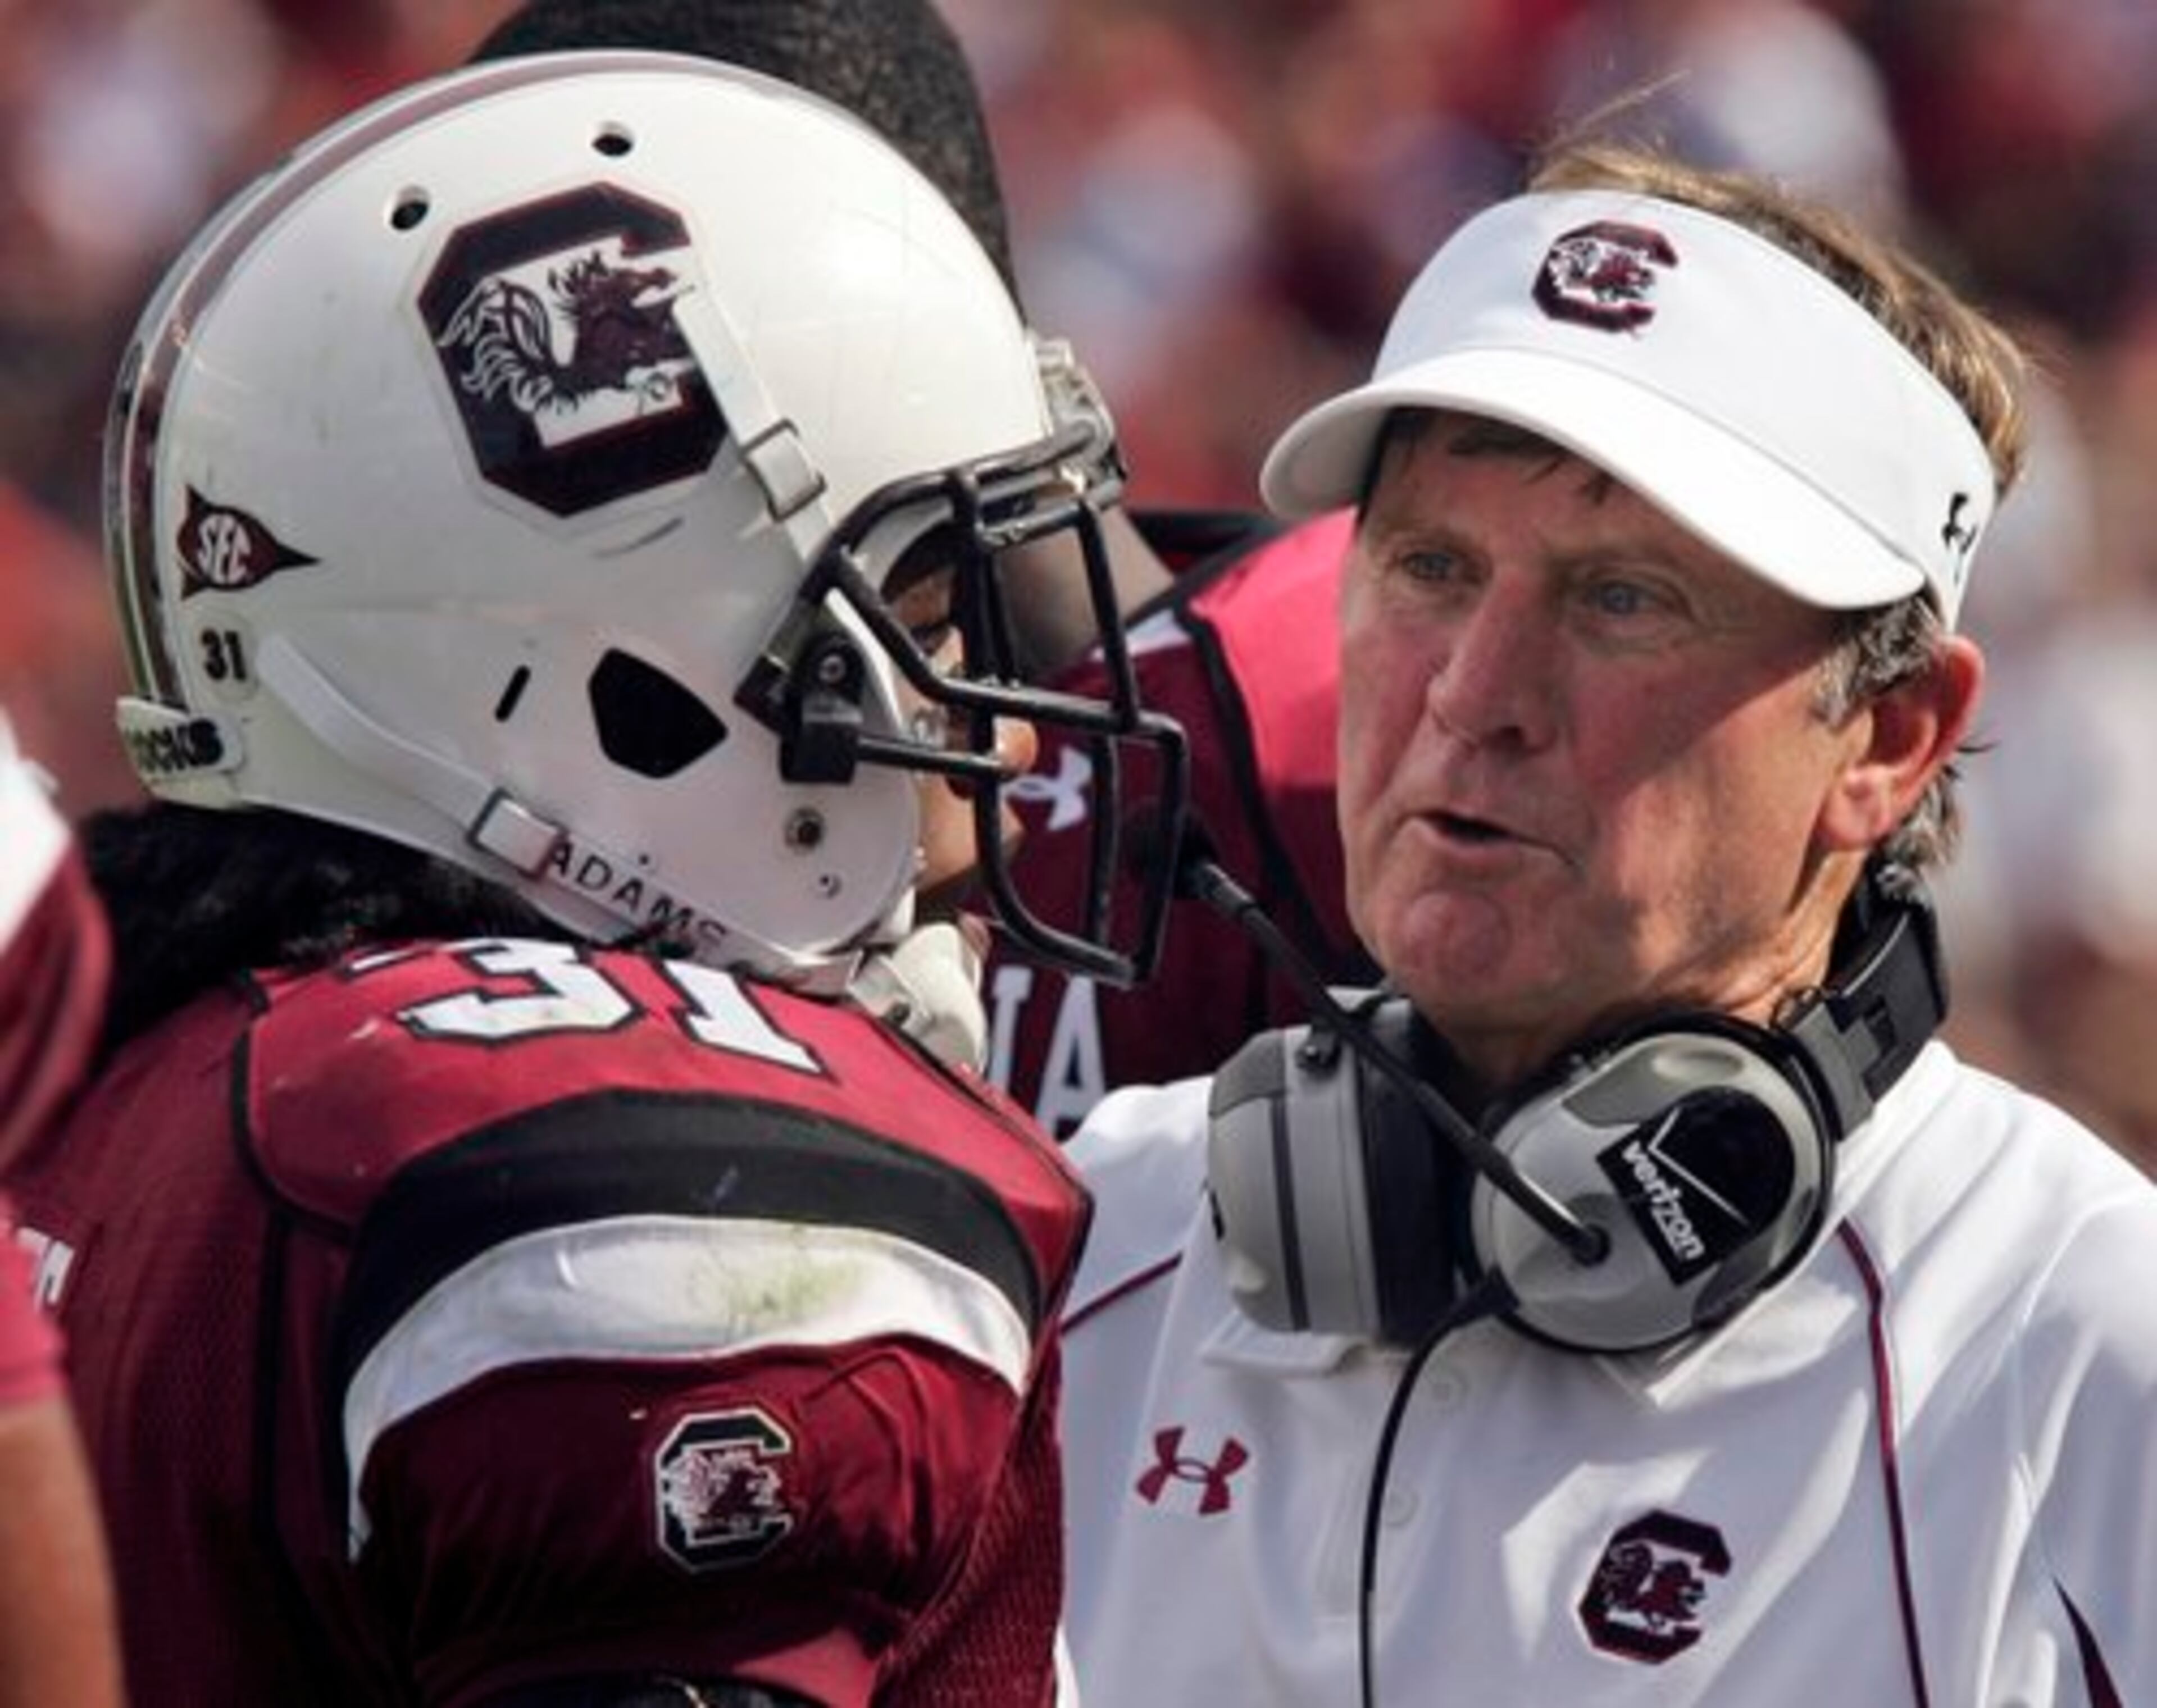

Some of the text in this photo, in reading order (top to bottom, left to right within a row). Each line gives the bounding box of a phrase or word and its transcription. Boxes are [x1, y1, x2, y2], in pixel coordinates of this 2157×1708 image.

[201, 629, 246, 681] 31
[353, 937, 826, 1076] 31
[1622, 1140, 1705, 1261] verizon
